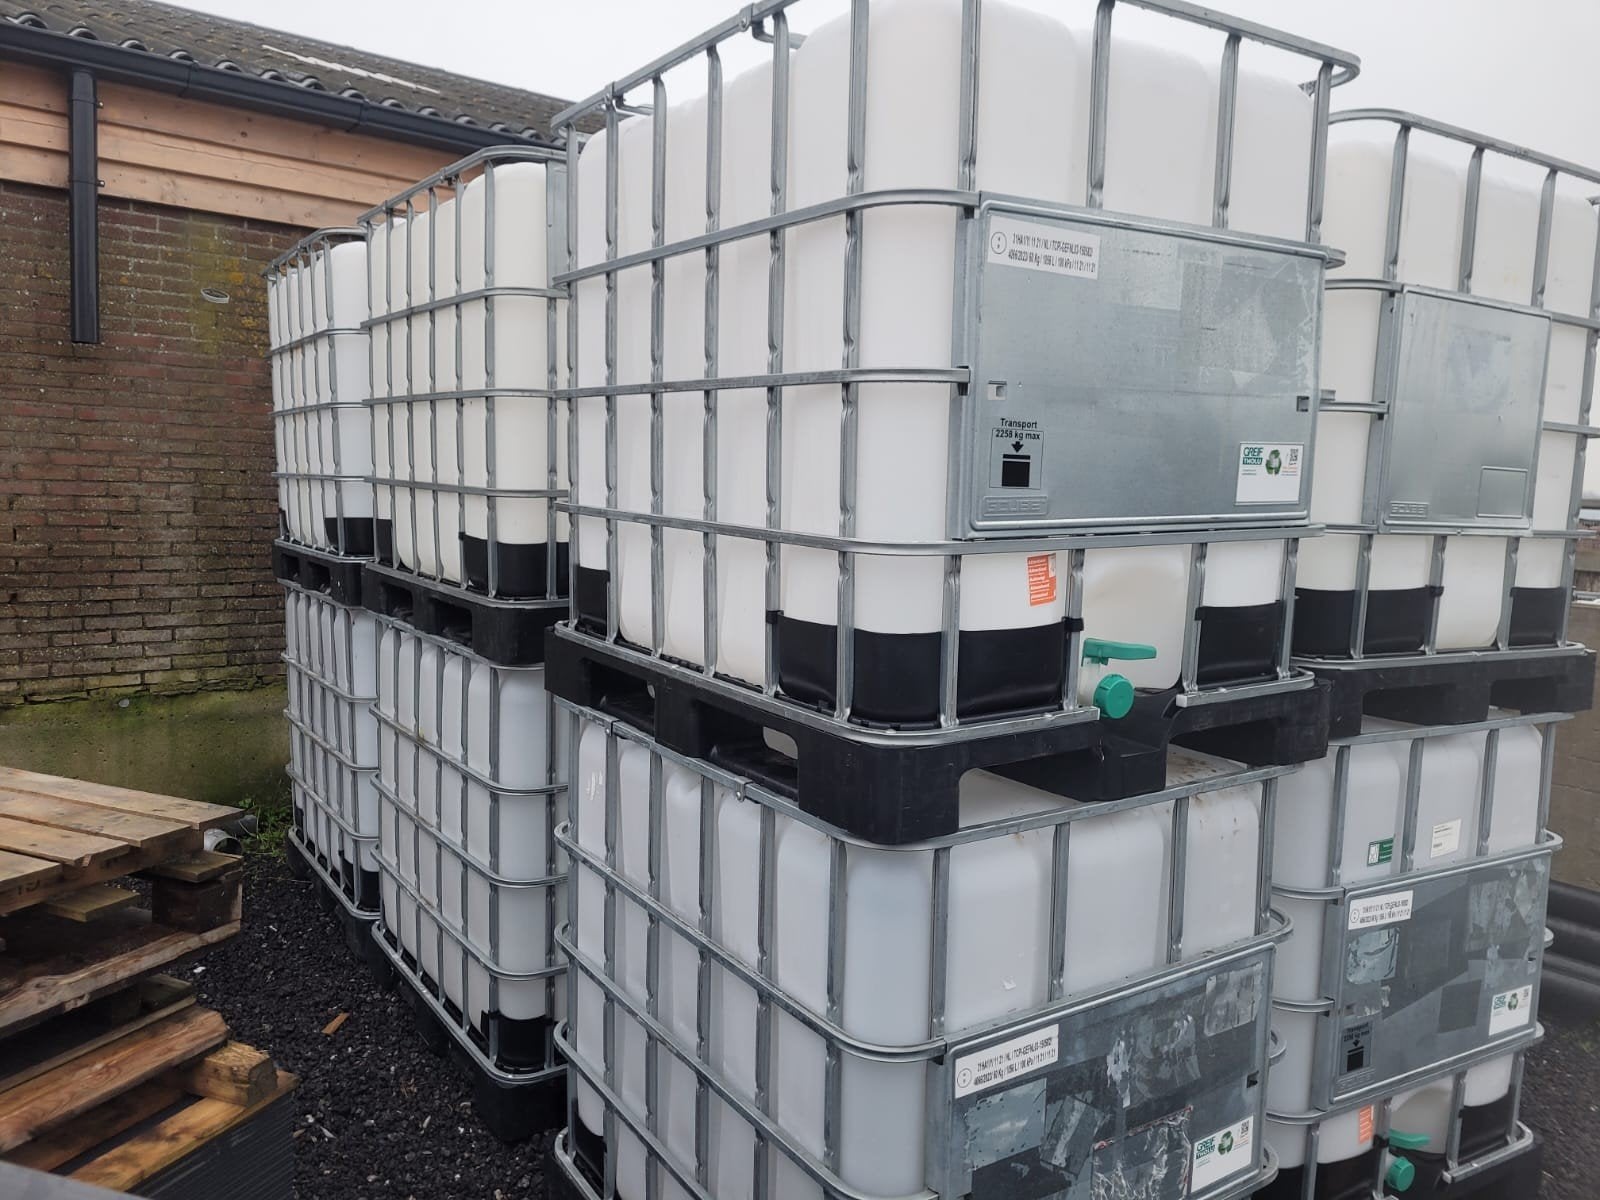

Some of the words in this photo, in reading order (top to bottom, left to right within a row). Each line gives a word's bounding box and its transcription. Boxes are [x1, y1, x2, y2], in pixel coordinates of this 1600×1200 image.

[1000, 418, 1038, 429] Transport
[995, 429, 1013, 439] 2258
[1014, 430, 1023, 441] kg
[1025, 432, 1041, 440] max
[1243, 446, 1264, 457] GREIF
